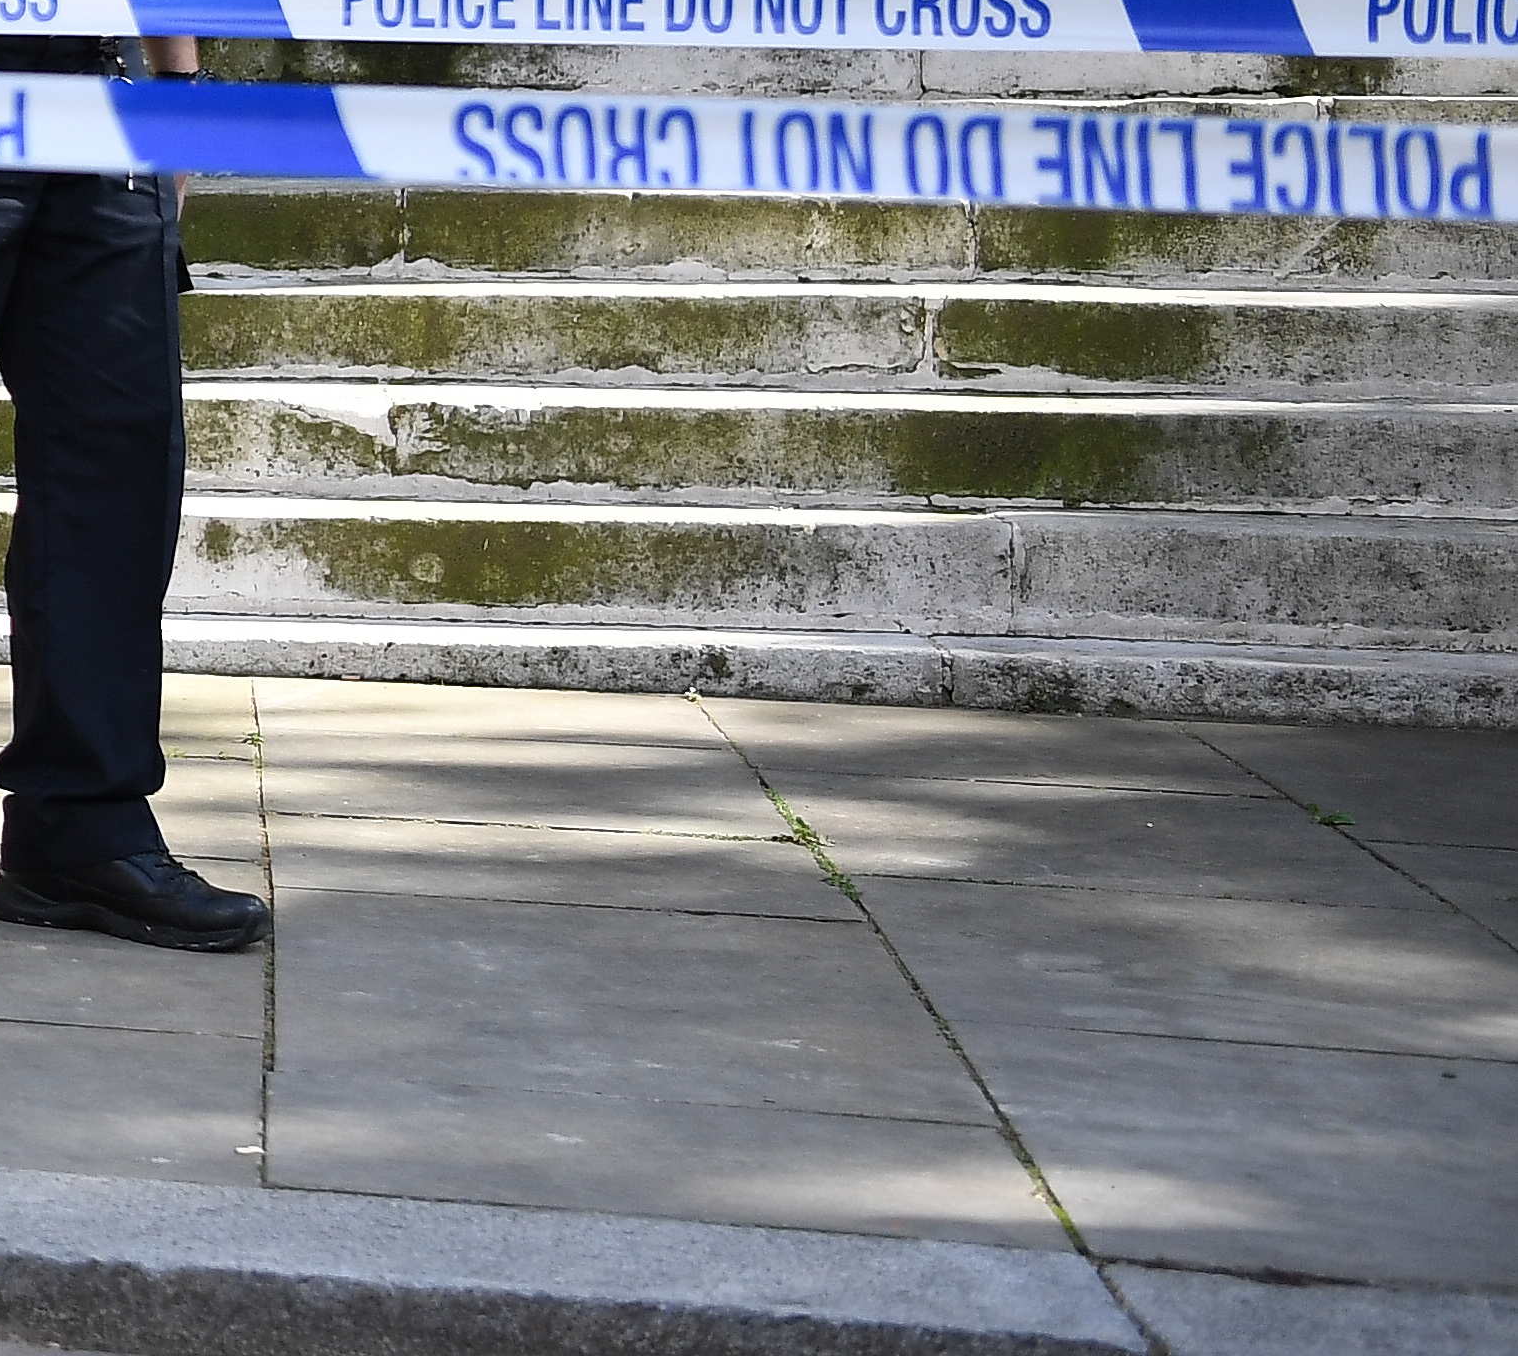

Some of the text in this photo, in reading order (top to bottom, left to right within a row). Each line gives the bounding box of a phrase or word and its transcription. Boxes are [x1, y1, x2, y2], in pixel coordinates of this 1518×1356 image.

[453, 100, 702, 186] CROSS
[903, 112, 1006, 201] DO
[1031, 116, 1199, 209] LINE
[1225, 121, 1494, 218] POLICE
